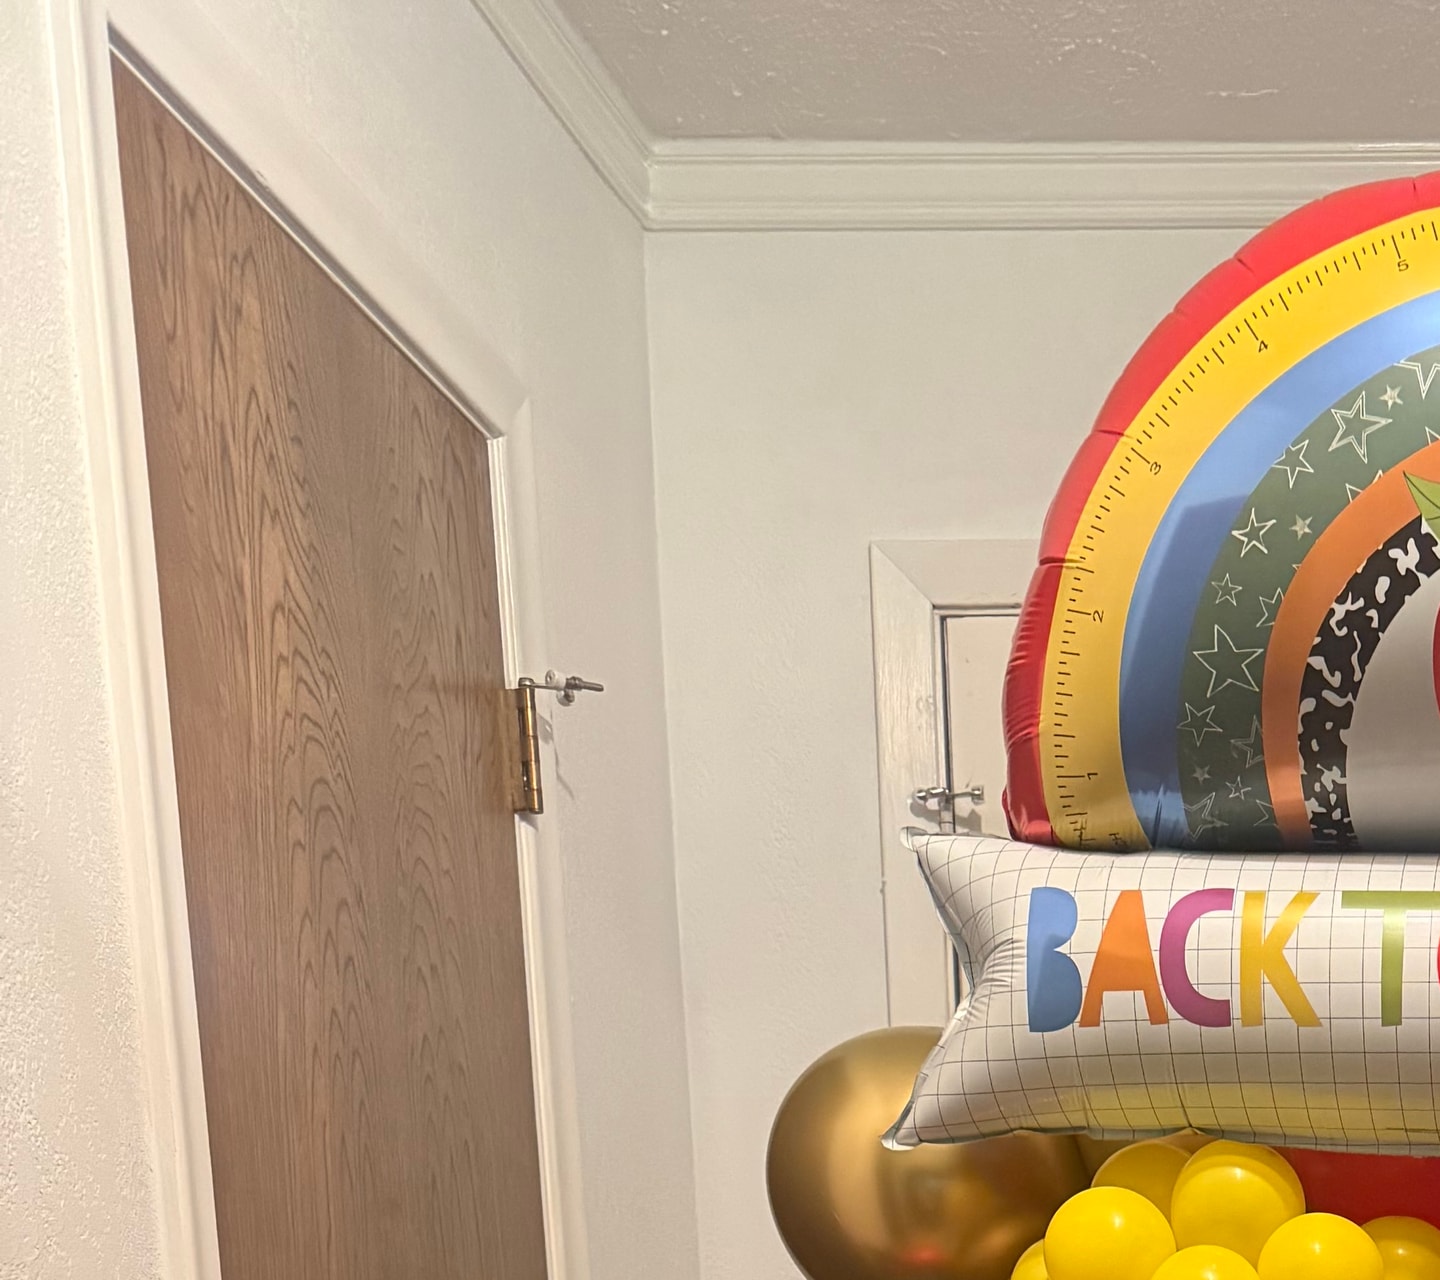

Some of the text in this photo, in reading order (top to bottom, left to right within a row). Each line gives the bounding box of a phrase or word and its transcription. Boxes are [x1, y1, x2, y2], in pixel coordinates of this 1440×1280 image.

[1086, 772, 1098, 780] 1
[1092, 609, 1104, 623] 2
[1149, 461, 1162, 475] 3
[1258, 340, 1269, 353] 4
[1397, 259, 1409, 272] 5
[1026, 886, 1323, 1032] BACK
